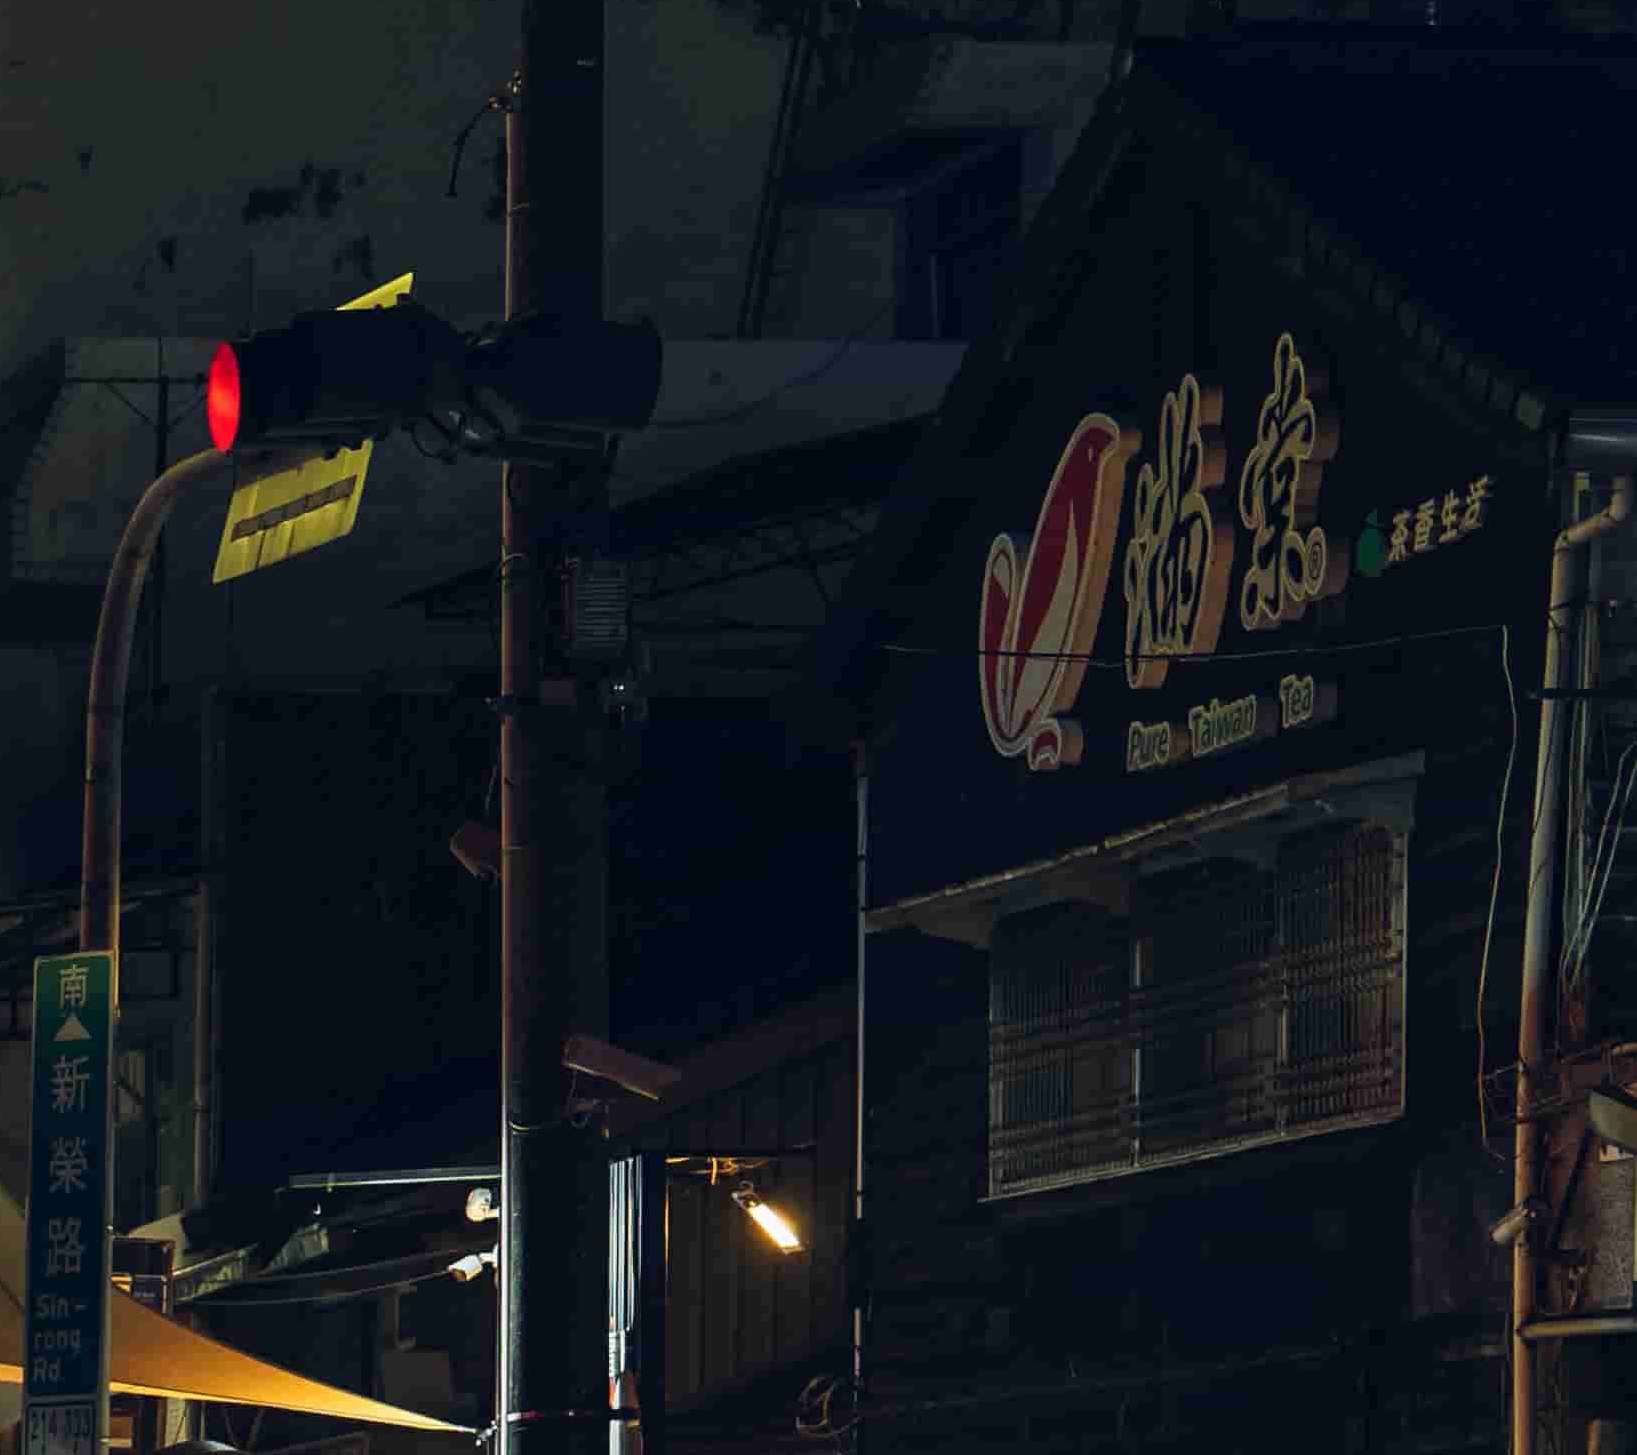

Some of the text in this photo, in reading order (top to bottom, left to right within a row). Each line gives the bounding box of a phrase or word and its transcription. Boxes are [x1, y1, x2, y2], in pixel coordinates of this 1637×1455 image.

[1127, 674, 1314, 773] Pure Taiwan Tea
[57, 964, 91, 1010] 南
[42, 1056, 91, 1281] 新榮路
